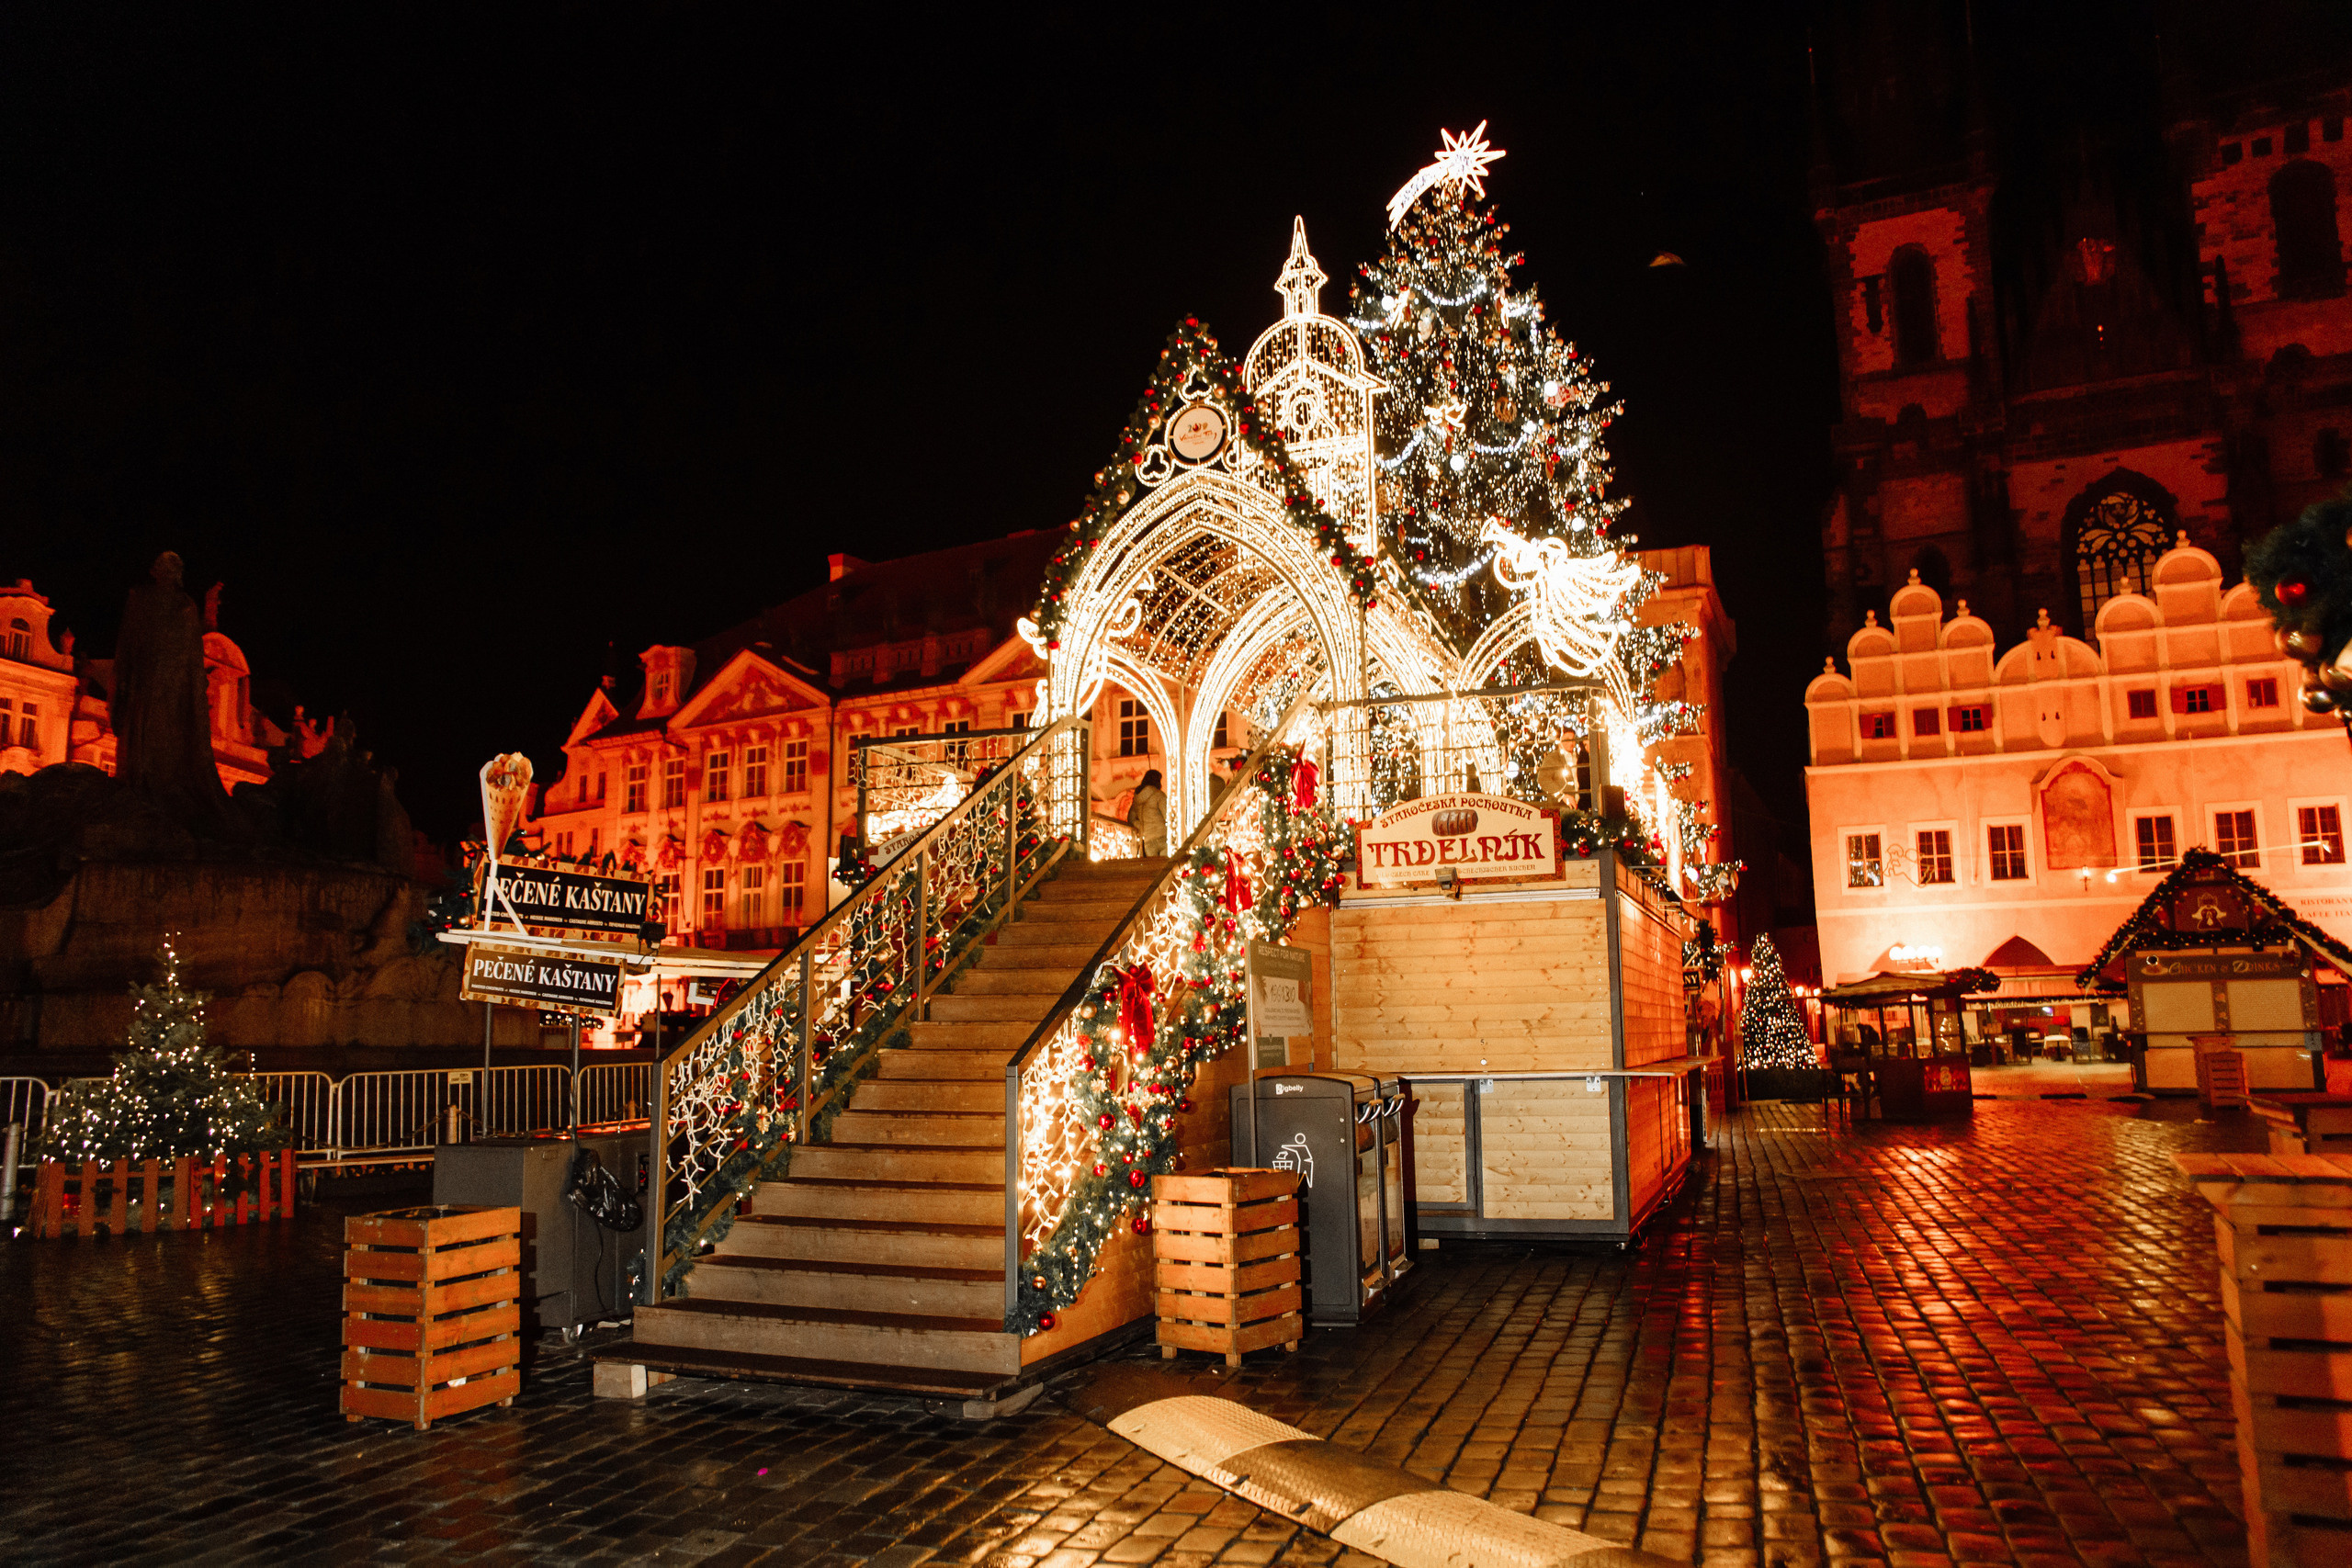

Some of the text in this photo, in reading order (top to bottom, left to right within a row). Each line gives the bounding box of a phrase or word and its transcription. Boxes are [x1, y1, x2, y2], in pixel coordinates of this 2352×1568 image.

[1381, 796, 1532, 828] STAROČESKÁ POCHOUTKA
[1367, 829, 1545, 868] TRDELNÍK
[565, 882, 646, 916] KAŠTANY
[1258, 945, 1280, 958] RESPECT
[1280, 949, 1289, 959] FOR
[473, 955, 617, 994] PEČENÉ KAŠTANY
[1275, 1083, 1304, 1095] Bigbelly
